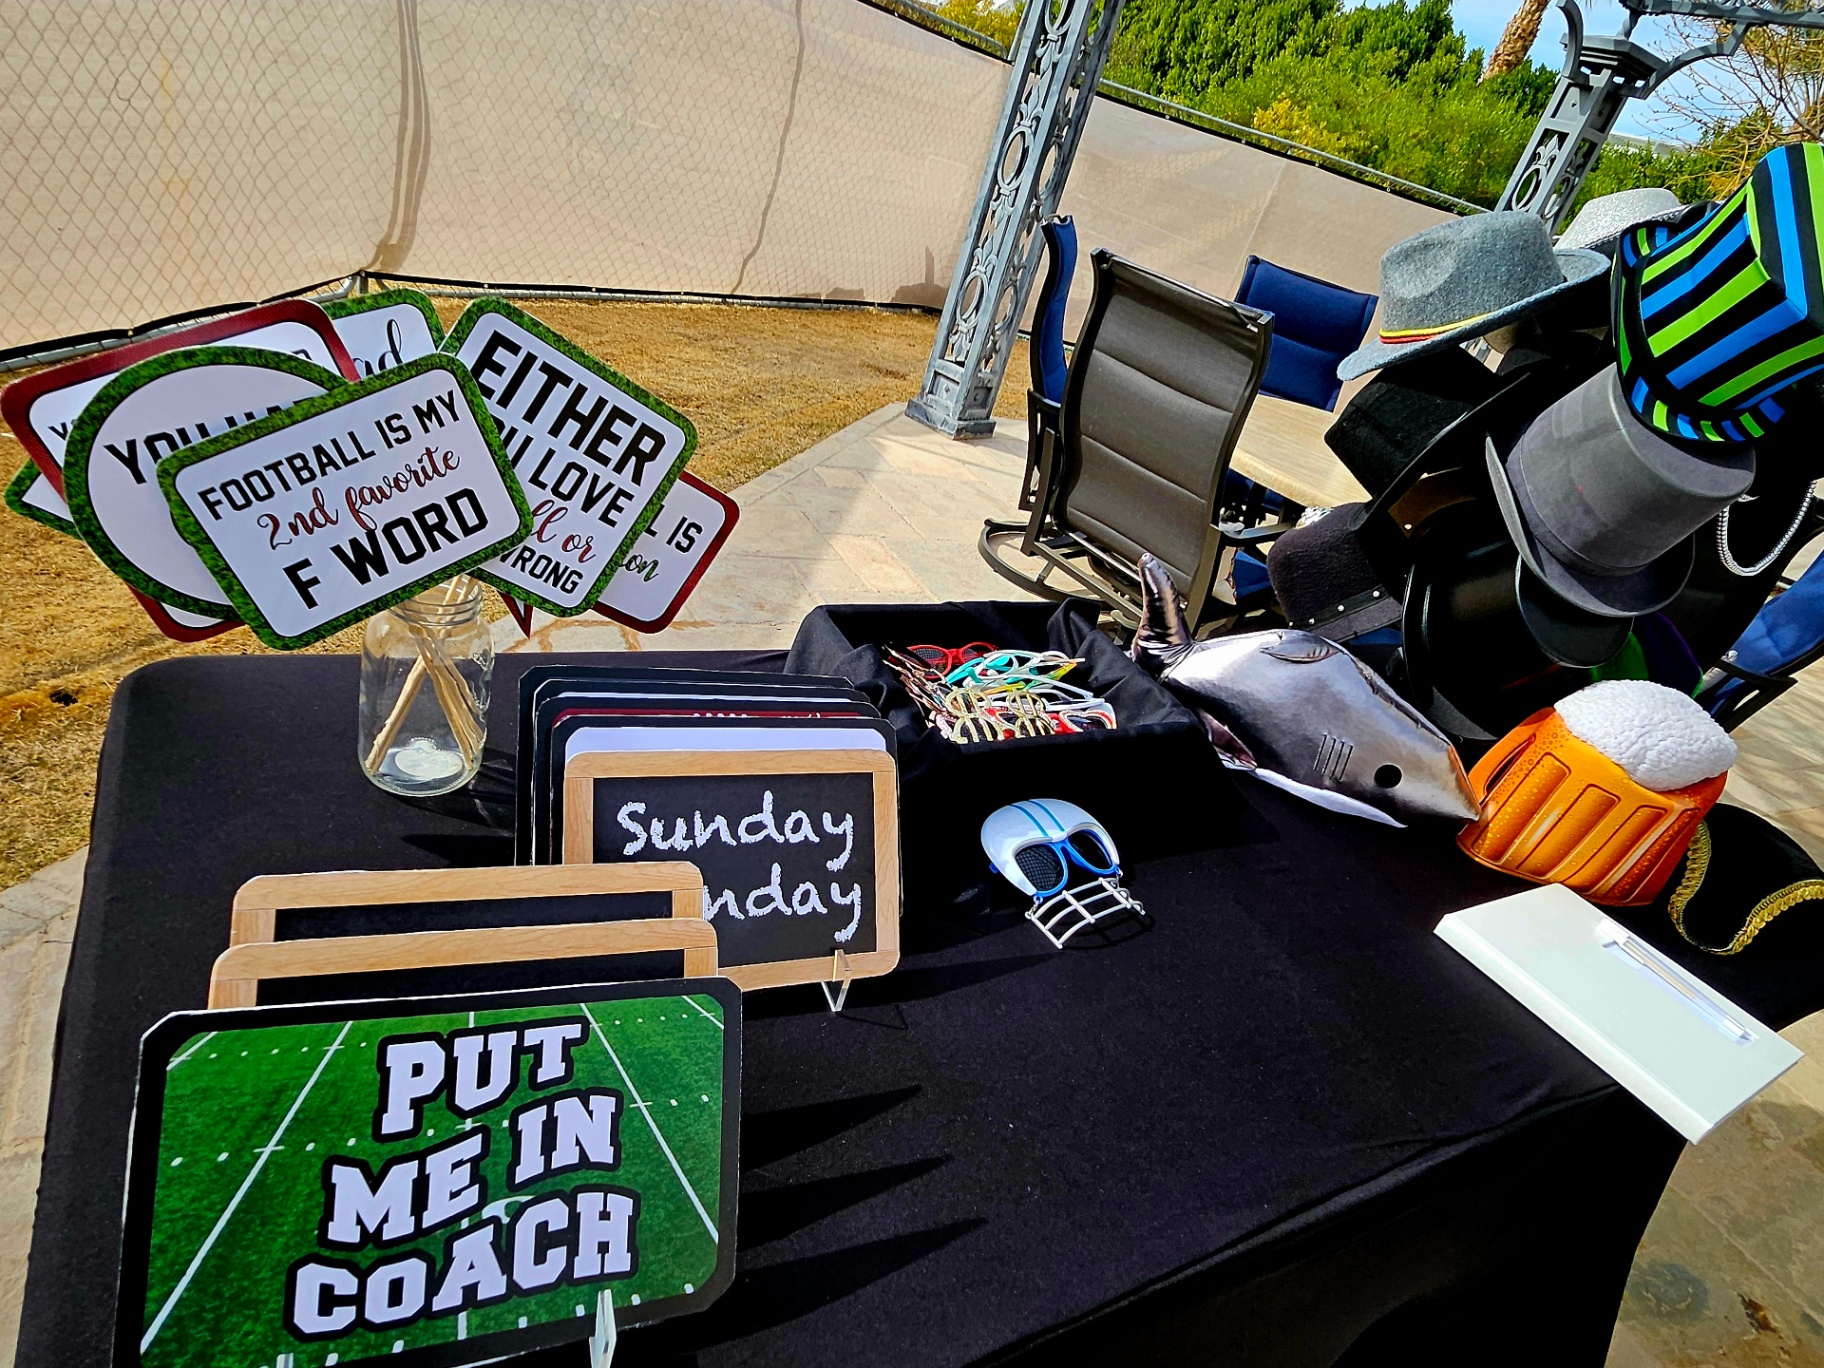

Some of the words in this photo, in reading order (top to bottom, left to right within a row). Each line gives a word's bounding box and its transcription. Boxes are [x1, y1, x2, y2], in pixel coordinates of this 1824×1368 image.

[197, 431, 376, 521] FOOTBALL
[374, 413, 412, 449] IS
[412, 390, 460, 434] MY
[470, 329, 667, 487] EITHER
[257, 487, 339, 550] 2nd
[345, 446, 460, 532] favorite
[528, 447, 635, 528] LOVE
[665, 516, 704, 554] IS
[282, 557, 321, 609] F
[329, 488, 488, 586] WORD
[561, 533, 596, 564] or
[617, 790, 854, 872] Sunday
[703, 862, 862, 943] nday
[380, 1023, 584, 1136] PUT
[327, 1132, 483, 1245] ME
[515, 1095, 617, 1184] IN
[292, 1191, 634, 1335] COACH
